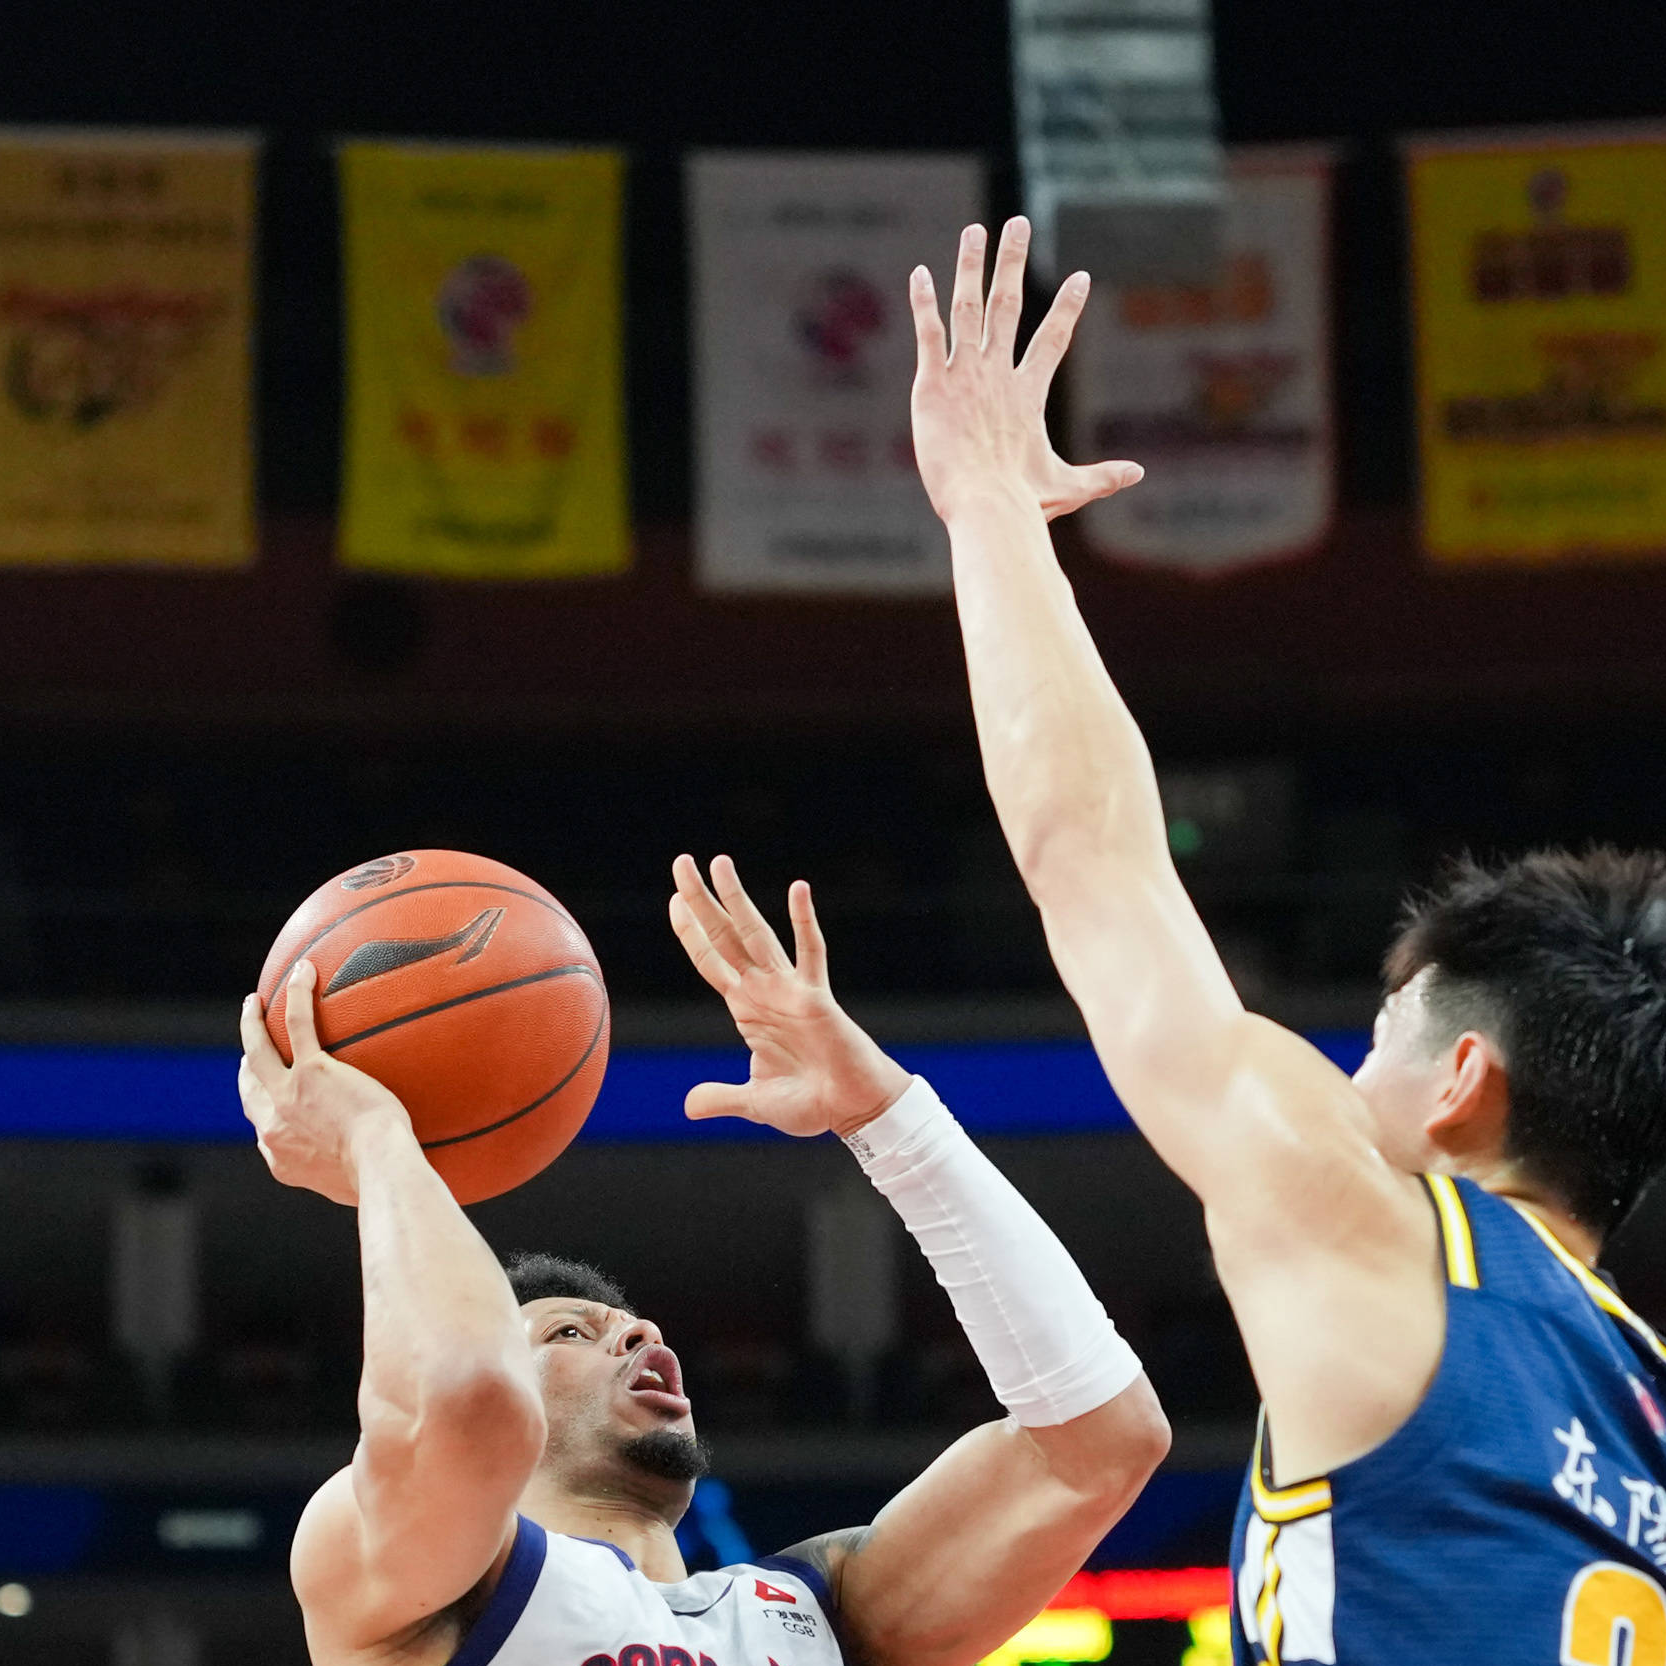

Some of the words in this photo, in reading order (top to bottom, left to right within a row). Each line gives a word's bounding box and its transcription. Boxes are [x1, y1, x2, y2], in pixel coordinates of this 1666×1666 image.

[762, 1608, 818, 1627] 广发银行
[782, 1621, 816, 1638] CGB
